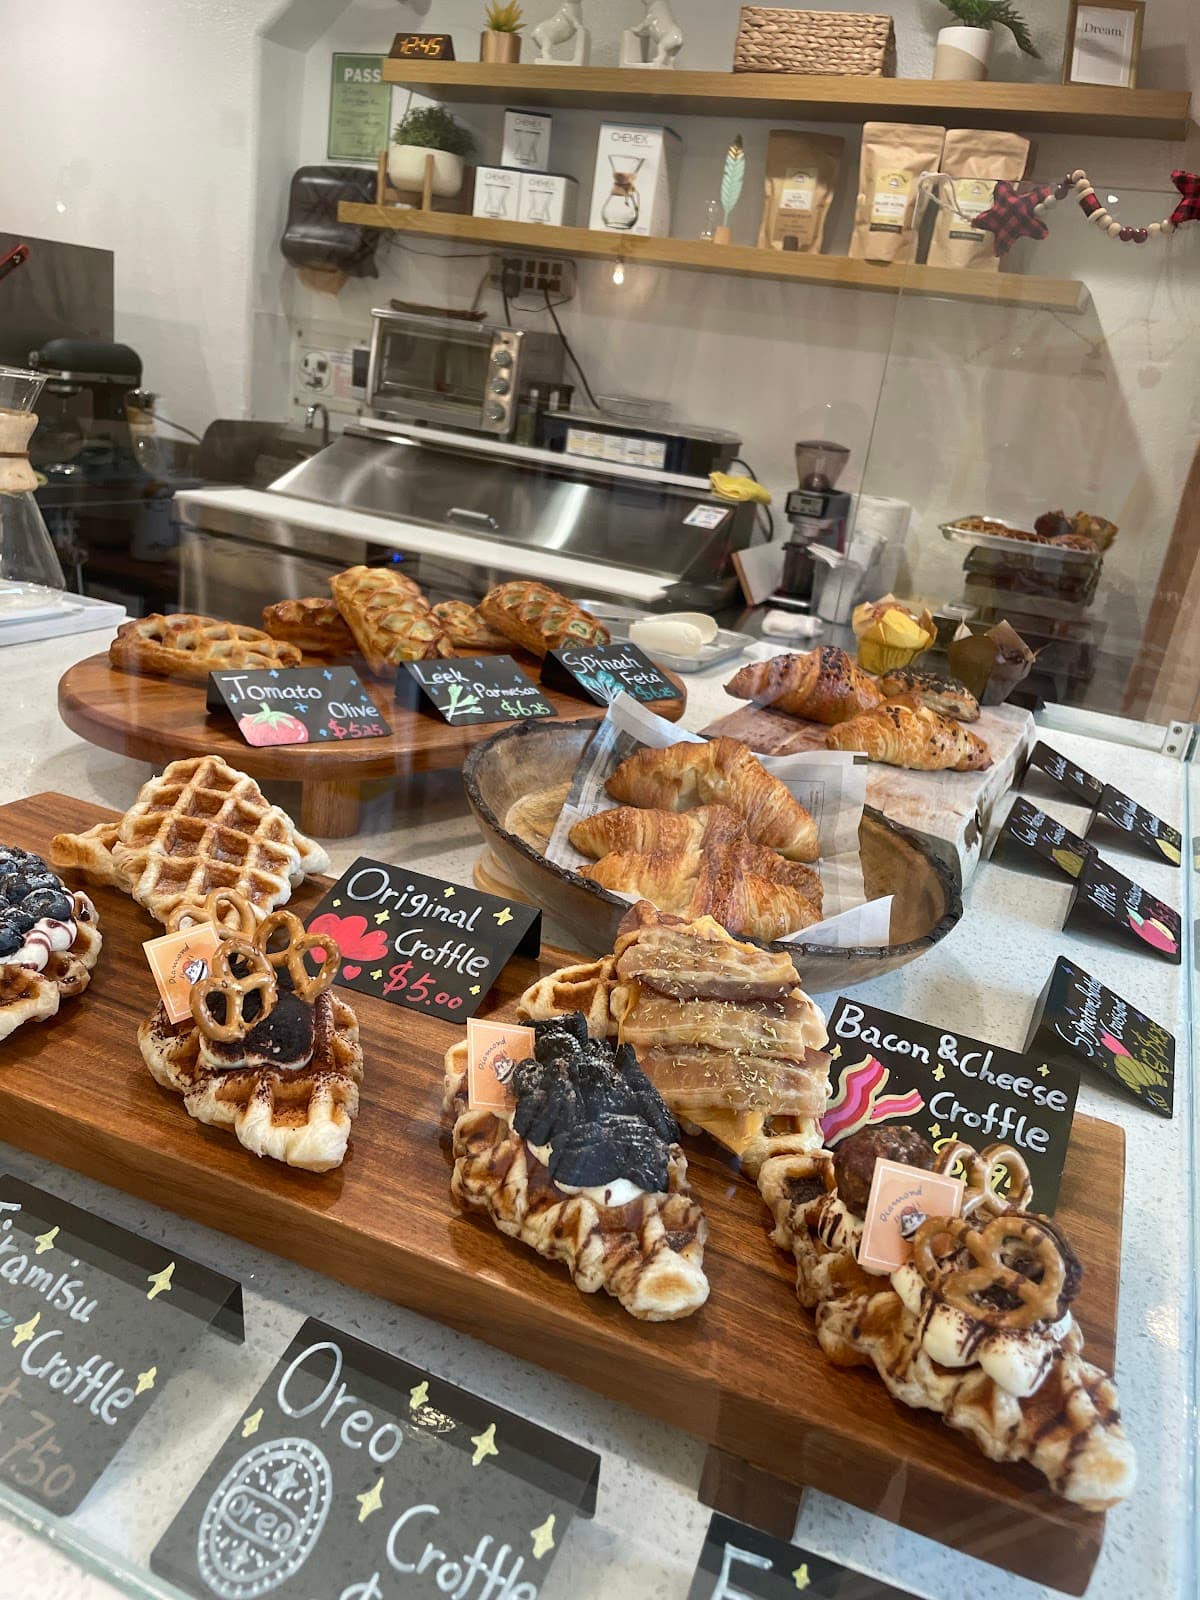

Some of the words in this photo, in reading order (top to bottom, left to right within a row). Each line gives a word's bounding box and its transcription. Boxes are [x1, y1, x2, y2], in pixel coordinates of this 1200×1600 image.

[343, 67, 382, 83] PASS
[221, 675, 323, 701] Tomato
[412, 664, 470, 685] Leek
[473, 682, 540, 698] Parmesan
[619, 671, 664, 686] Feta
[327, 701, 379, 719] Olive
[346, 867, 482, 932] Original
[394, 929, 490, 977] Croffle
[382, 960, 463, 1009] $5.00
[834, 1003, 930, 1064] Bacon
[959, 1050, 1069, 1112] Cheese
[929, 1091, 1050, 1153] Croffle
[0, 1201, 98, 1323] ramisu
[21, 1329, 136, 1425] Croffle
[277, 1341, 403, 1463] Oreo
[228, 1493, 293, 1547] oreo
